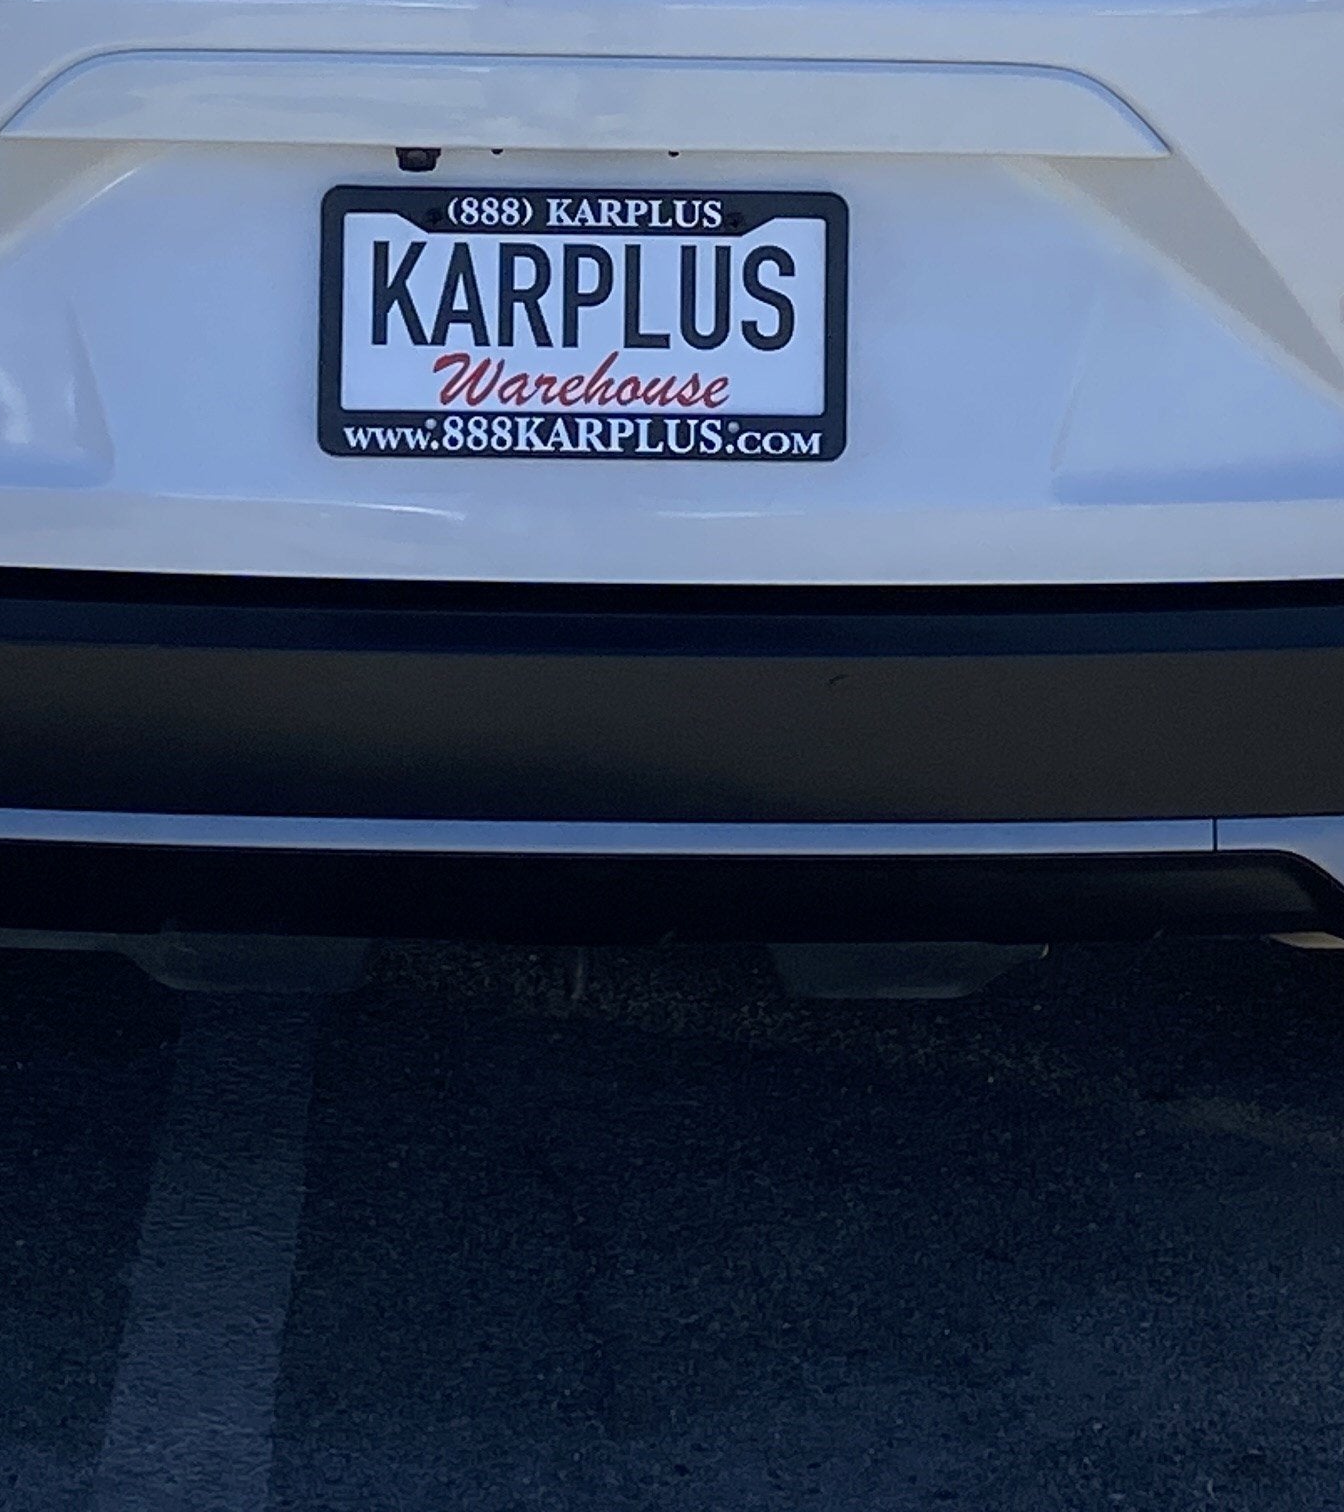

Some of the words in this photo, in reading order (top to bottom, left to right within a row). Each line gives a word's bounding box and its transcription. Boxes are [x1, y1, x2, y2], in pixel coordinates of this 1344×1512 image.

[447, 196, 533, 226] (888)
[546, 199, 723, 229] KARPLUS
[370, 239, 796, 352] KARPLUS
[433, 350, 731, 409] Warehouse
